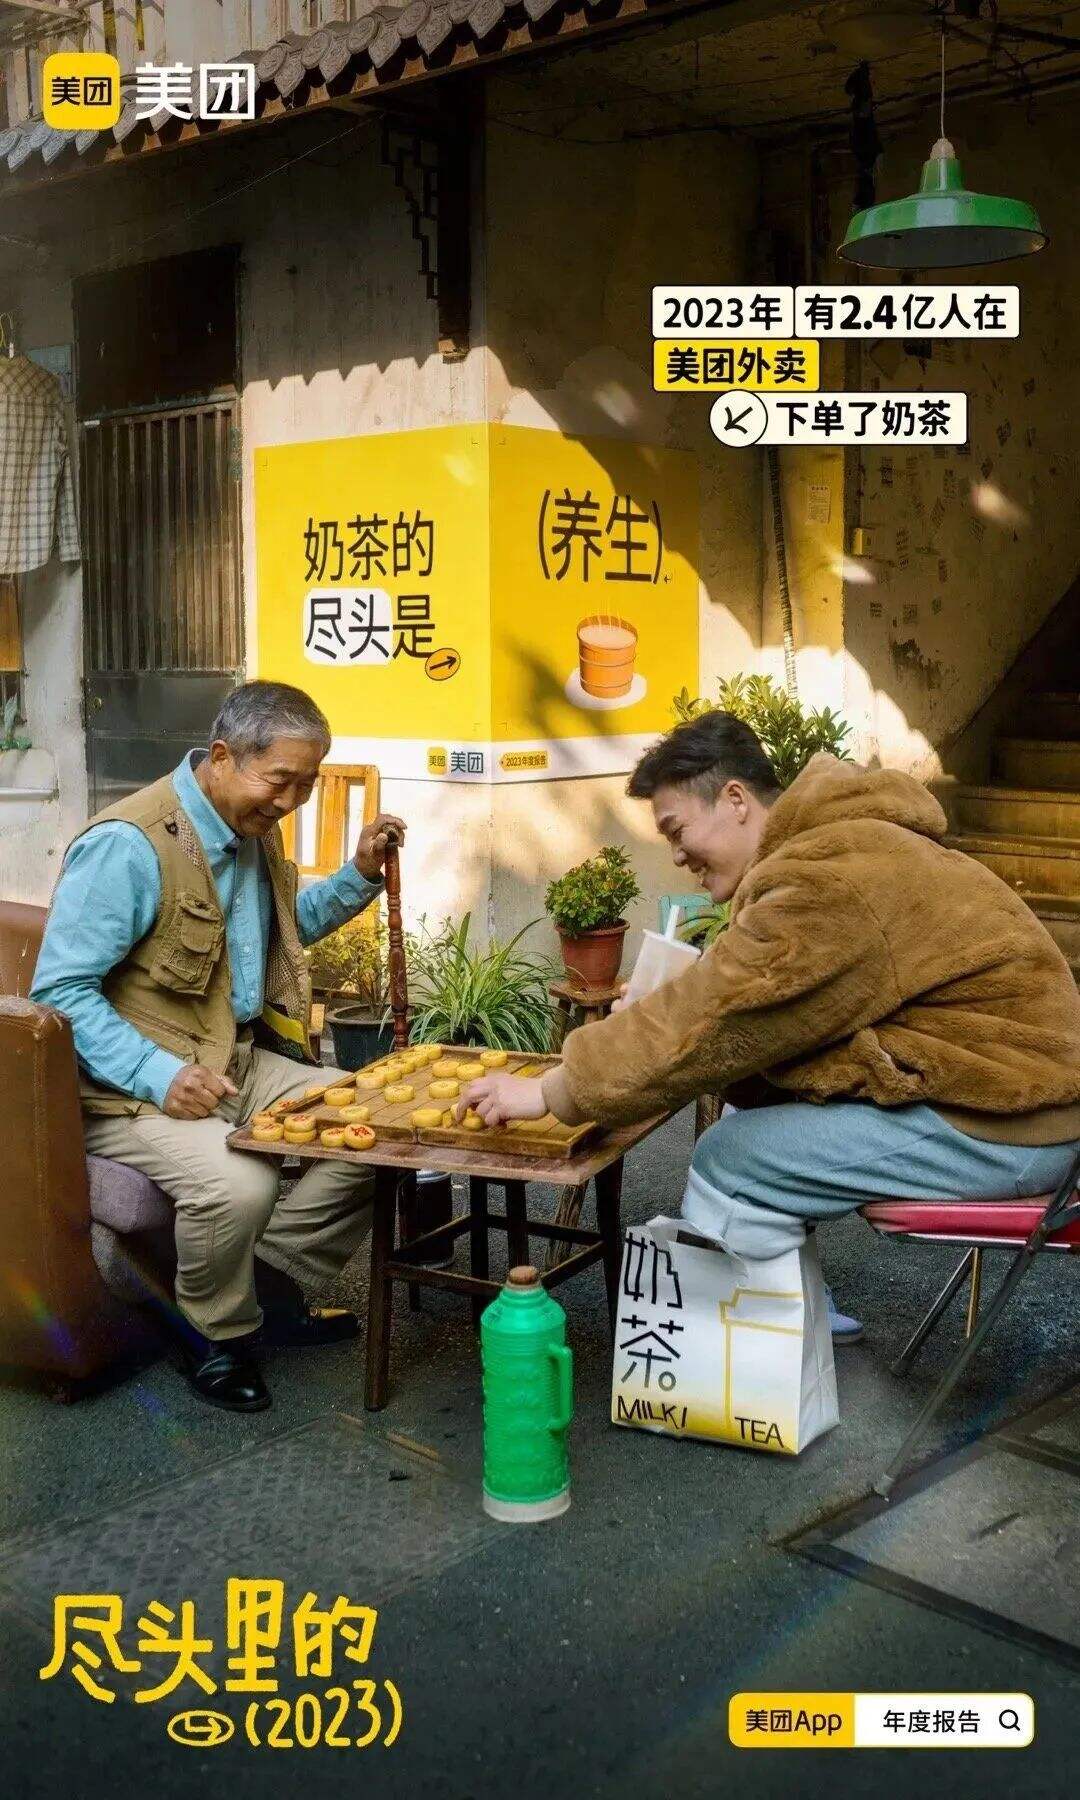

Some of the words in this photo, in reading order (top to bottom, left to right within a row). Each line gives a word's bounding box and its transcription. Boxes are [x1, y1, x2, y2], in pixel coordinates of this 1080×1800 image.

[303, 509, 435, 583] 奶茶的
[304, 594, 437, 661] 尽头是
[450, 751, 484, 774] 美团
[506, 754, 547, 768] 2023年度报告
[734, 1416, 785, 1449] TEA
